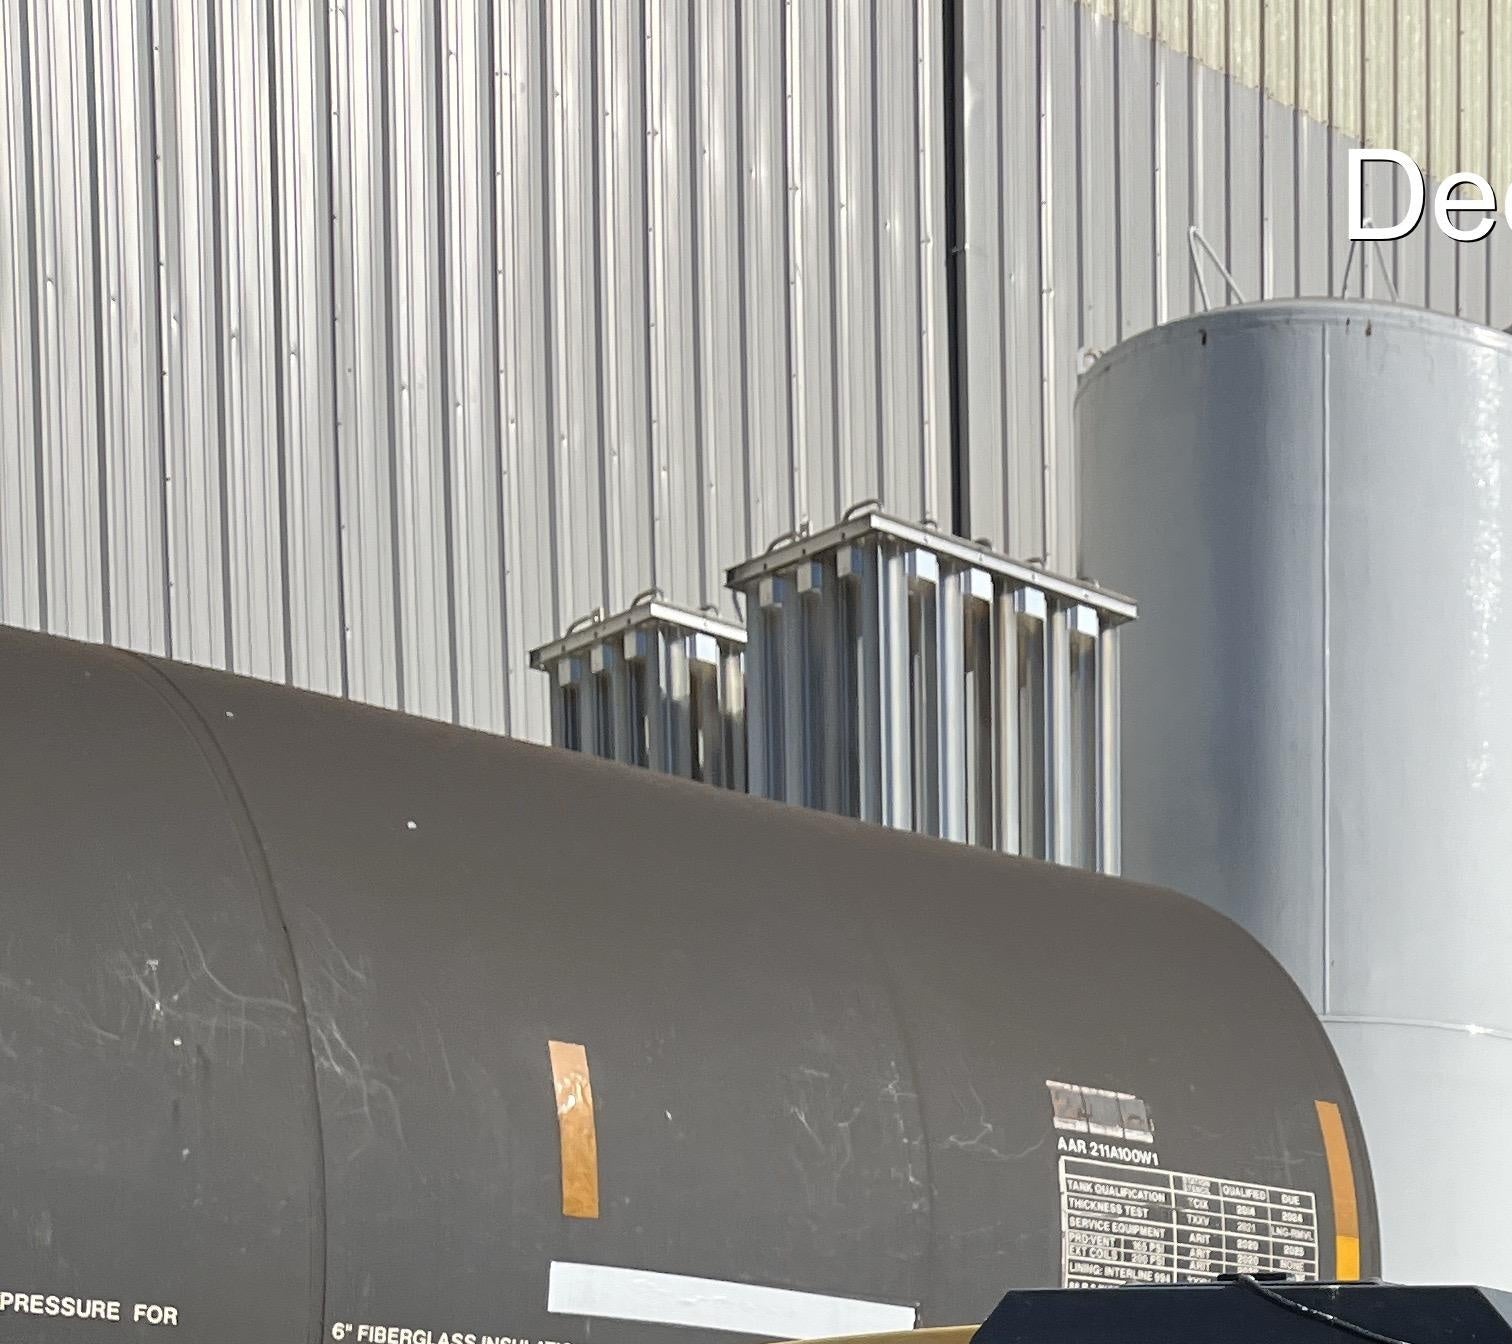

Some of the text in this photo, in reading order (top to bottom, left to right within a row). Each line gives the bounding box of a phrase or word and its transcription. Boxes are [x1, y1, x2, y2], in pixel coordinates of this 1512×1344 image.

[1057, 1136, 1159, 1166] AAR 211A100W1
[1067, 1180, 1093, 1193] TANK
[1094, 1184, 1166, 1202] QUALIFICATION
[1223, 1185, 1266, 1201] QUALIFIED
[1069, 1198, 1122, 1214] THICKNESS
[1124, 1205, 1149, 1218] TEST
[1069, 1216, 1110, 1231] SERVICE
[1111, 1222, 1166, 1239] EQUIPMENT
[0, 1292, 178, 1325] PRESSURE FOR
